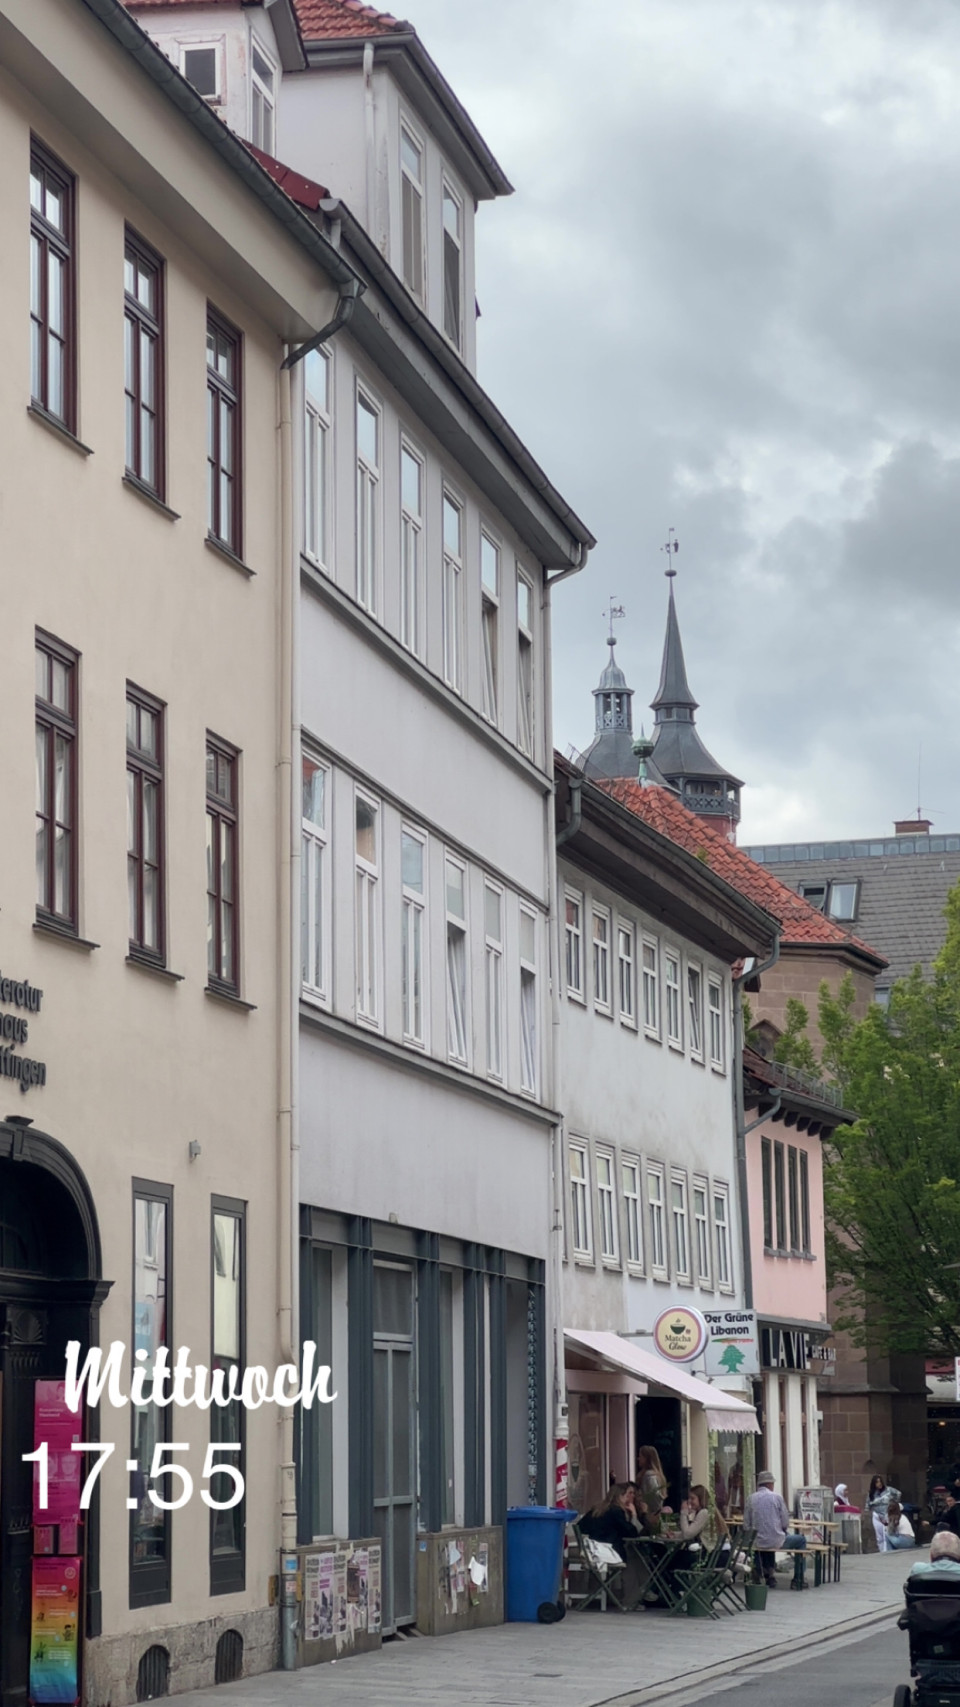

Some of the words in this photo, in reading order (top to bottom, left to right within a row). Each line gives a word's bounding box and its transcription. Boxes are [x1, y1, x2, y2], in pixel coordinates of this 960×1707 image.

[704, 1314, 721, 1323] Der
[724, 1312, 754, 1323] Grüne
[711, 1326, 749, 1336] Libanon
[664, 1334, 691, 1342] Matcha
[668, 1341, 687, 1351] Glow
[769, 1327, 788, 1368] LA
[790, 1331, 811, 1370] VIE
